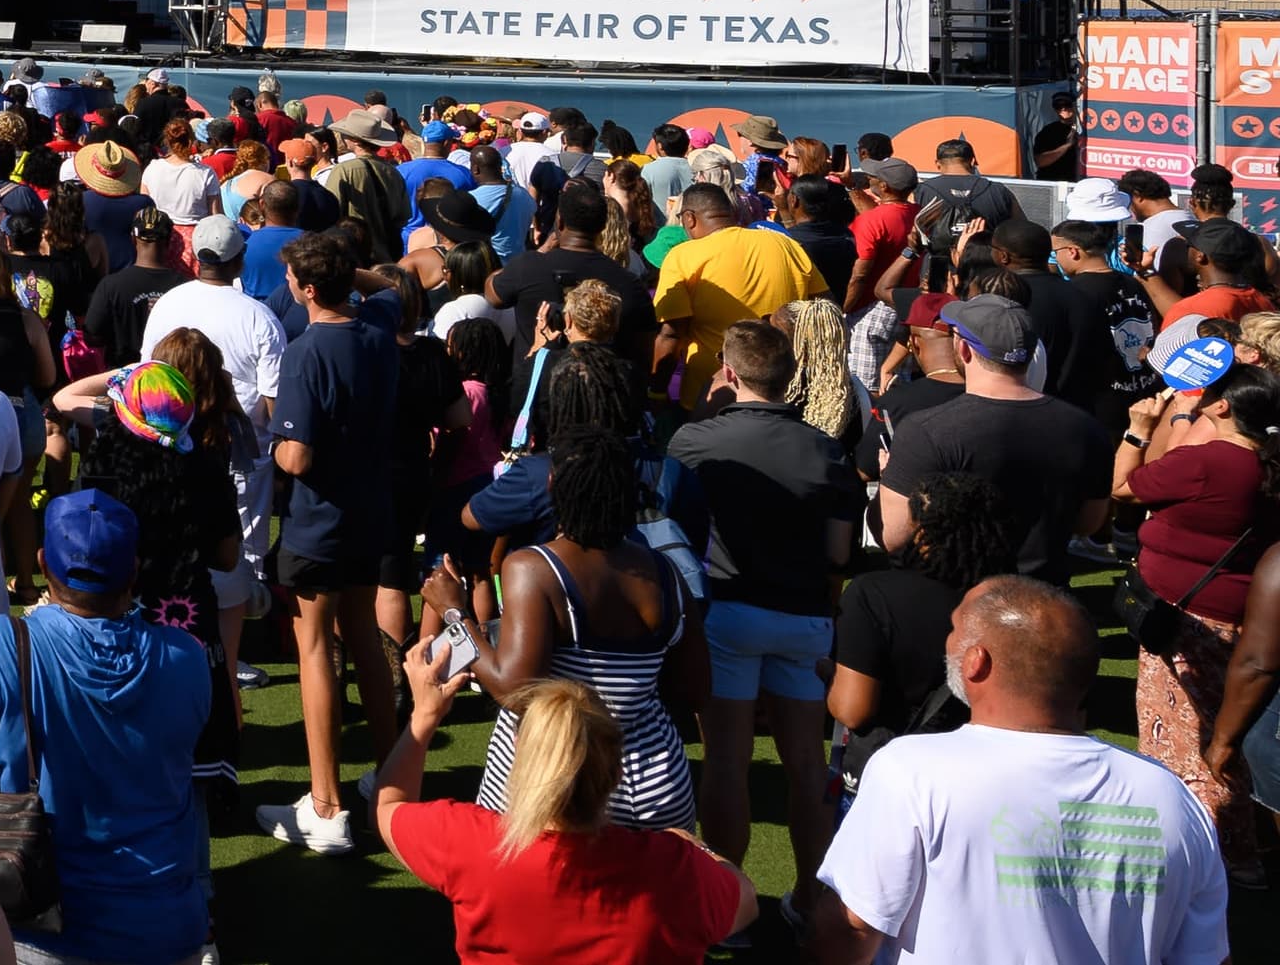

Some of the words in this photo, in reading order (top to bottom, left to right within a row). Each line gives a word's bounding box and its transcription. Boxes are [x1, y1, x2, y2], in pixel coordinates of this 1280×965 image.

[420, 8, 522, 36] STATE
[535, 12, 620, 40] FAIR
[632, 13, 688, 41] OF
[699, 14, 832, 45] TEXAS
[1087, 36, 1190, 66] MAIN
[1087, 65, 1190, 93] STAGE
[1088, 151, 1183, 172] BIGTEX.COM
